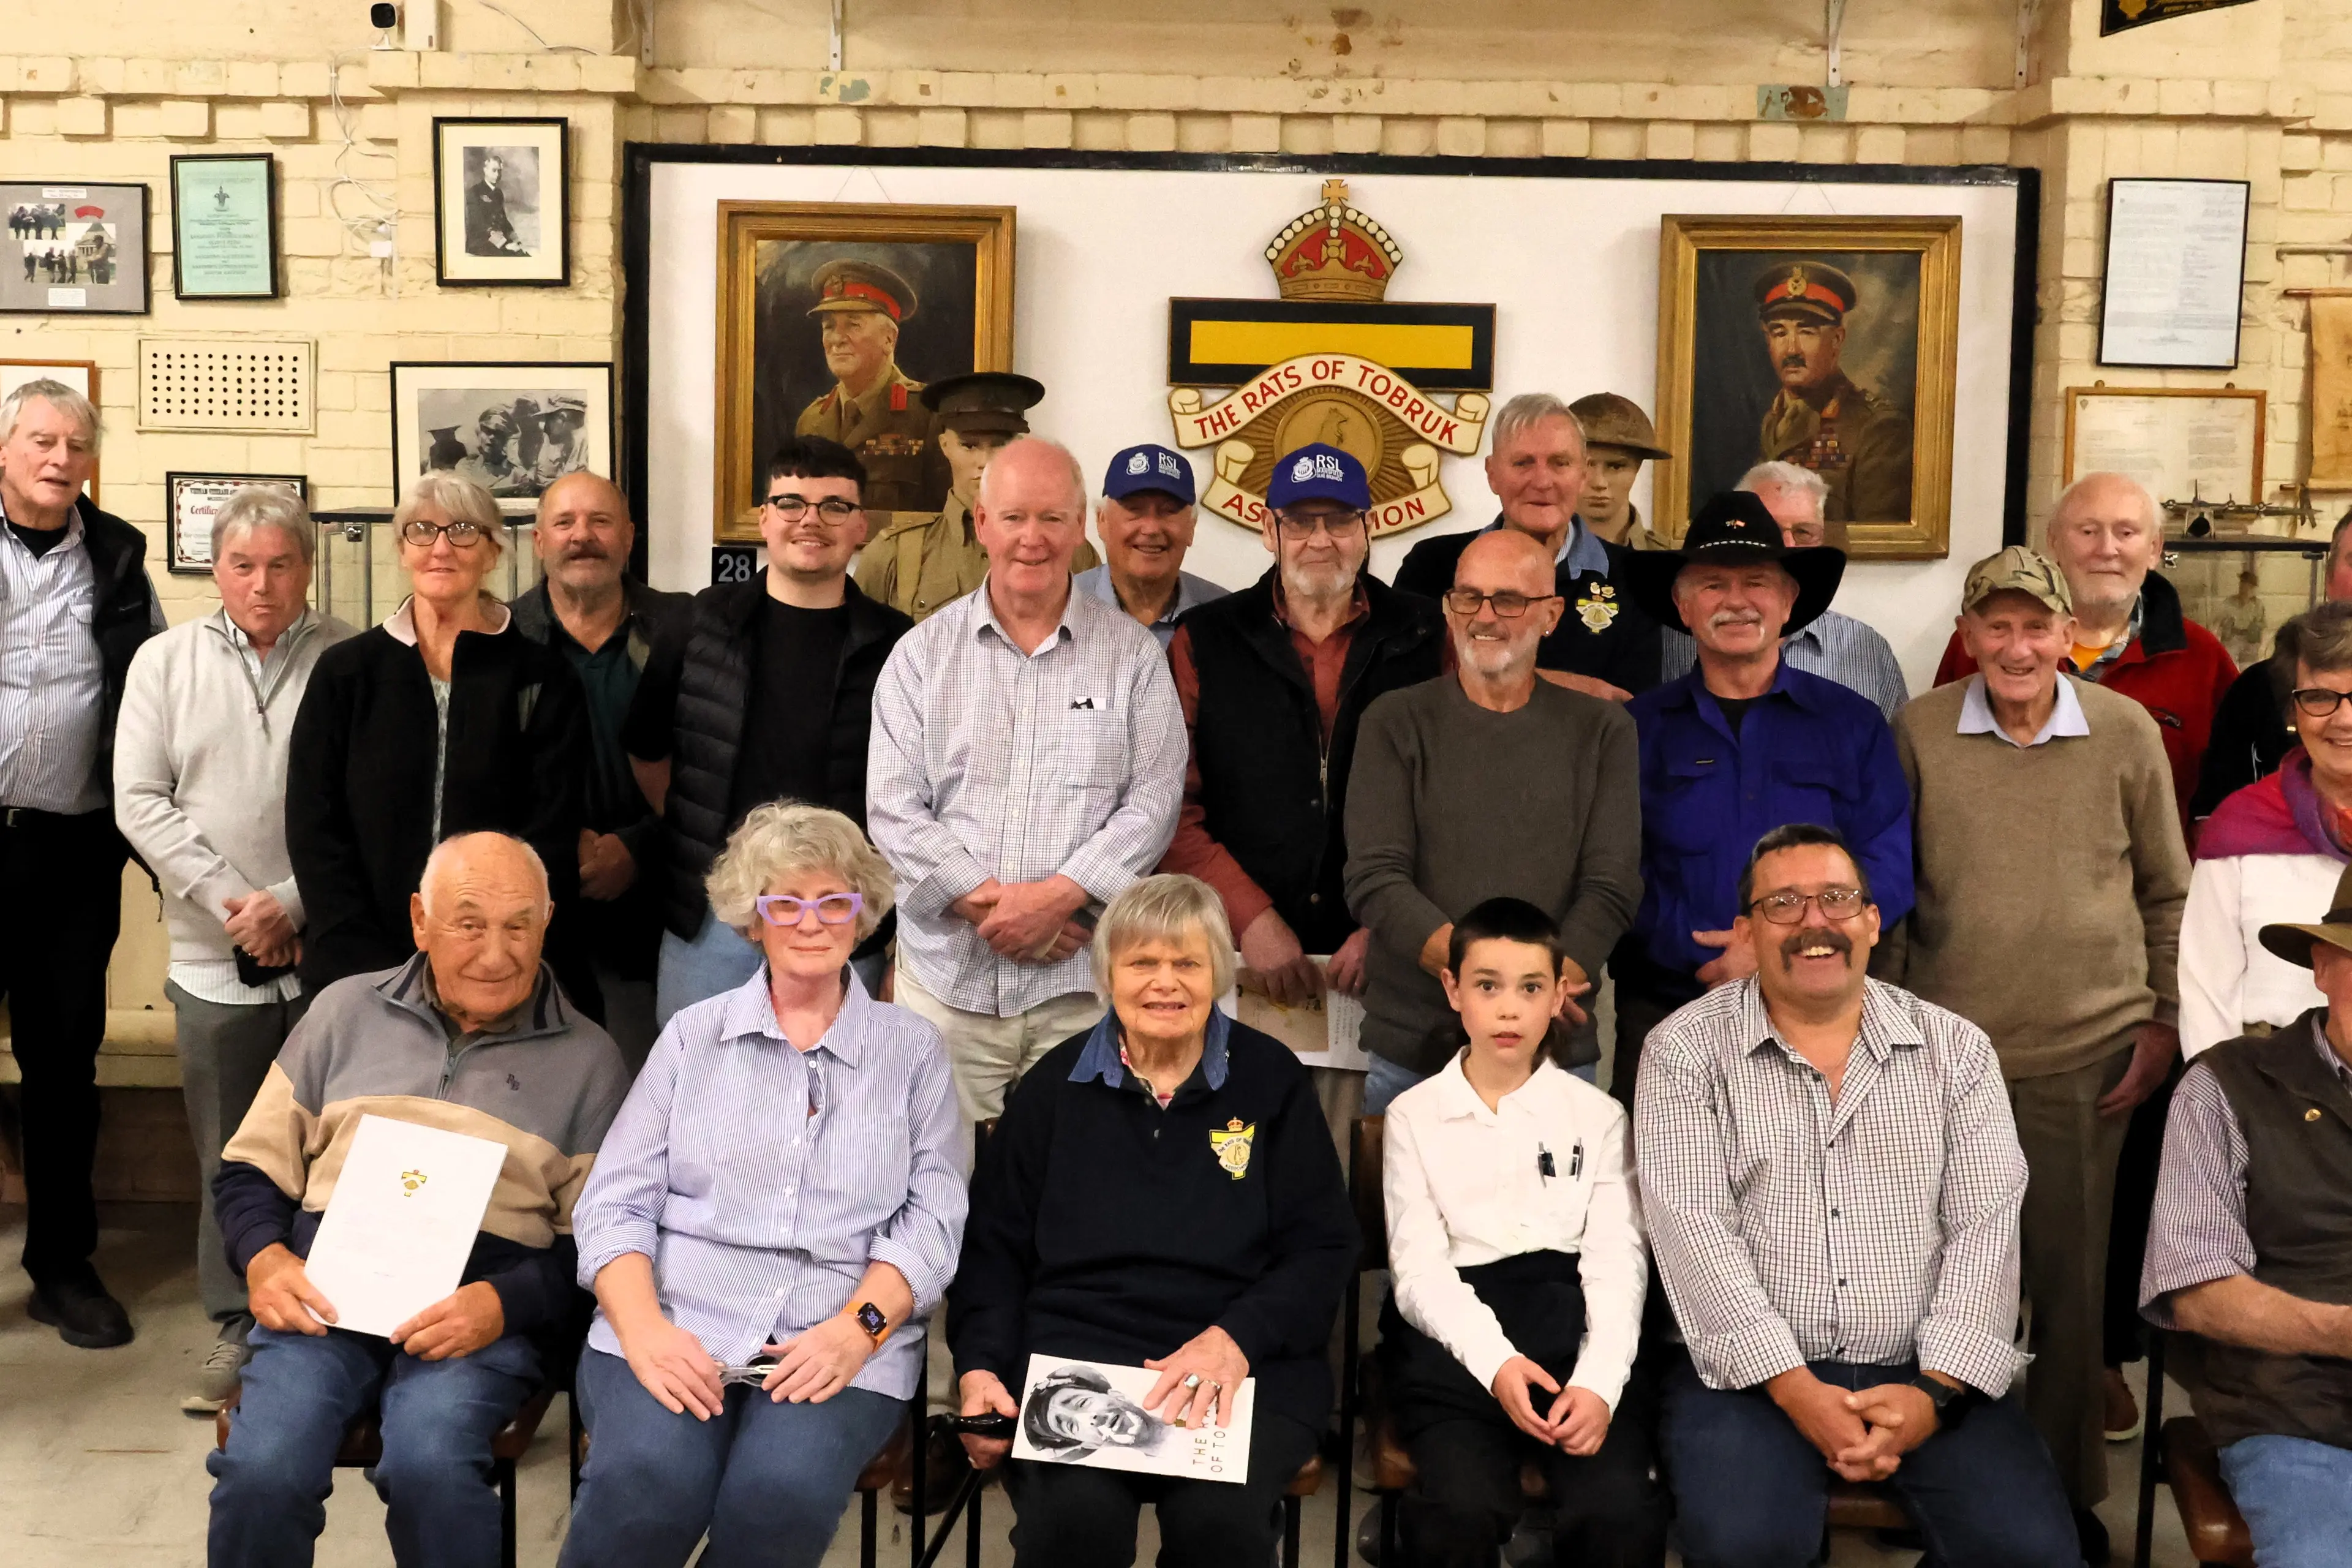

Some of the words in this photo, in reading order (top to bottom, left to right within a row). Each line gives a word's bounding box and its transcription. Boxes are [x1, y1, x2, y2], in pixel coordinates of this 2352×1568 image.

[1193, 404, 1242, 440] THE
[1241, 365, 1302, 414] RATS
[1311, 360, 1346, 381] OF
[1358, 364, 1462, 446] TOBRUK
[1316, 454, 1342, 470] RSL
[718, 554, 750, 582] 28
[1193, 1438, 1207, 1465] THE
